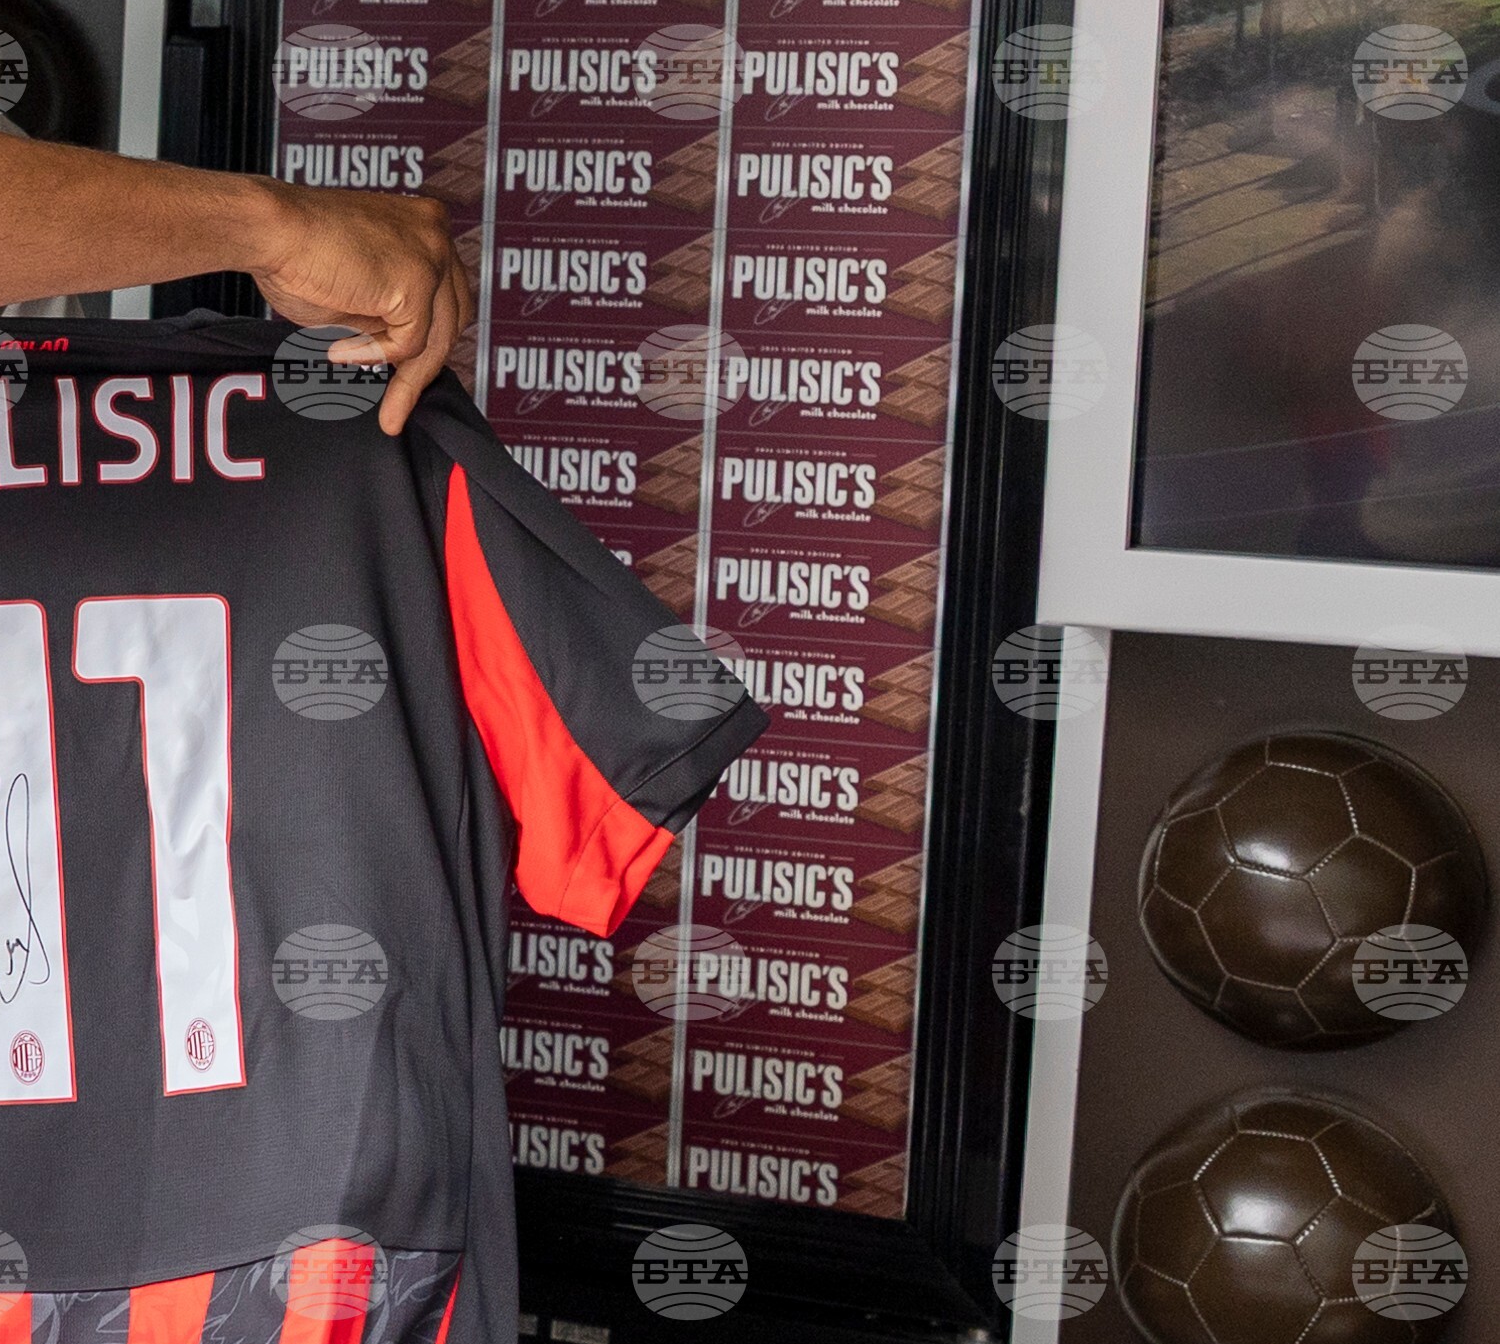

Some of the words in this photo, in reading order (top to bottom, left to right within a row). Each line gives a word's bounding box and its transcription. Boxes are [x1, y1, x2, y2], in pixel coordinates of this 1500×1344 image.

[289, 46, 429, 91] PULISIC'S
[510, 49, 657, 93] PULISIC'S
[742, 51, 899, 97] PULISIC'S
[816, 99, 841, 110] milk
[843, 99, 895, 112] chocolate
[285, 144, 424, 188] PULISIC'S
[505, 150, 652, 194] PULISIC'S
[736, 153, 893, 201] PULISIC'S
[575, 197, 598, 207] milk
[600, 197, 649, 208] chocolate
[811, 203, 836, 214] milk
[838, 203, 889, 215] chocolate
[500, 250, 647, 295] PULISIC'S
[732, 256, 887, 304] PULISIC'S
[570, 296, 593, 307] milk
[595, 297, 644, 309] chocolate
[806, 305, 830, 316] milk
[832, 305, 883, 318] chocolate
[496, 346, 643, 395] PULISIC'S
[726, 359, 882, 407] PULISIC'S
[560, 495, 584, 505] milk
[585, 495, 634, 508] chocolate
[721, 458, 877, 509] PULISIC'S
[794, 508, 819, 520] milk
[821, 509, 872, 523] chocolate
[715, 557, 870, 610] PULISIC'S
[789, 609, 814, 621] milk
[815, 610, 866, 625] chocolate
[778, 809, 803, 820] milk
[805, 810, 855, 826] chocolate
[701, 855, 855, 912] PULISIC'S
[773, 908, 798, 920] milk
[799, 910, 851, 925] chocolate
[695, 952, 849, 1010] PULISIC'S
[690, 1049, 843, 1109] PULISIC'S
[687, 1146, 838, 1206] PULISIC'S
